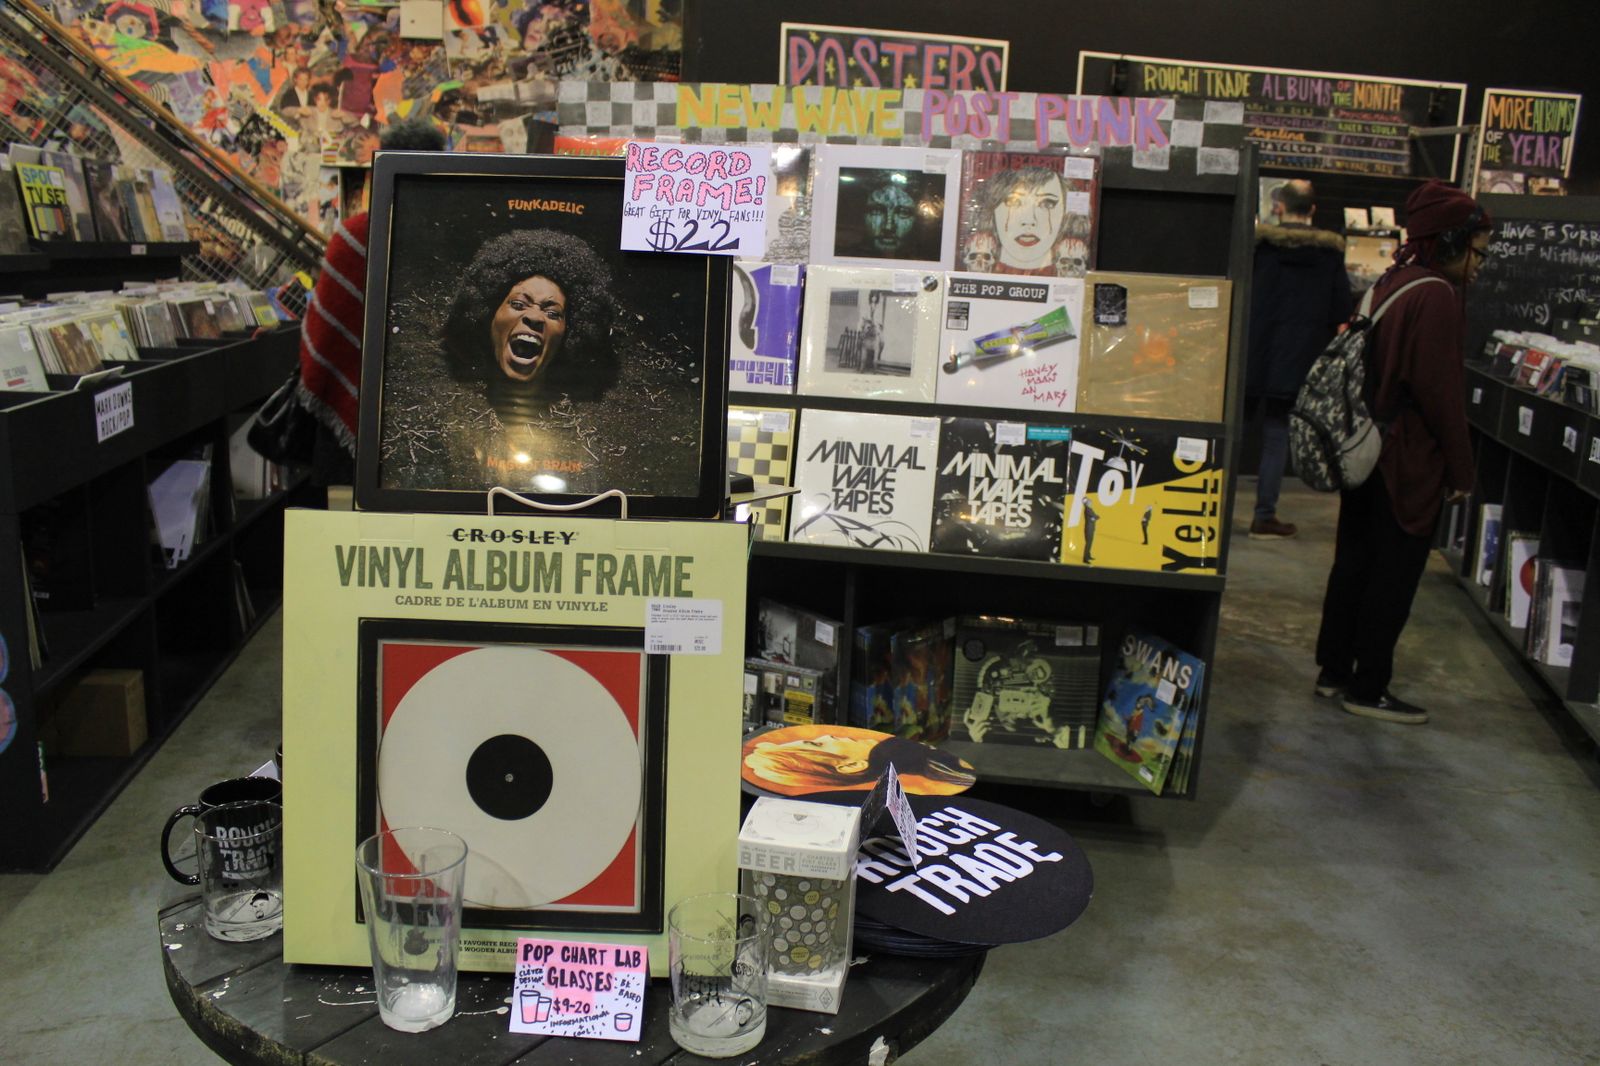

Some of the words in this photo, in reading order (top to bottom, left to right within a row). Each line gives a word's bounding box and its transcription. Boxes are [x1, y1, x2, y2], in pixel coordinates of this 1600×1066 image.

[788, 33, 1002, 94] POSTERS
[1144, 64, 1199, 93] ROUGH
[1204, 69, 1252, 97] TRADE
[1262, 74, 1332, 107] ALBUMS
[1337, 80, 1350, 91] OF
[1333, 92, 1351, 106] THE
[1353, 82, 1404, 111] MONTH
[675, 84, 785, 131] NEW
[792, 86, 904, 139] WAVE
[921, 90, 1020, 144] POST
[1035, 93, 1170, 151] PUNK
[1487, 95, 1534, 131] MORE
[1532, 98, 1575, 133] ALBUMS
[1486, 131, 1504, 143] OF
[626, 143, 751, 180] RECORD
[1483, 144, 1501, 162] THE
[1508, 132, 1571, 170] YEAR!
[27, 186, 42, 202] TV
[632, 174, 766, 210] FRAME!
[508, 199, 585, 215] FUNKADELIC
[624, 202, 646, 217] GREAT
[650, 204, 674, 219] GIFT
[678, 208, 691, 220] FOR
[696, 209, 724, 221] VINYL
[729, 210, 764, 222] FANS!!!
[645, 217, 740, 252] $22
[953, 283, 976, 294] THE
[980, 285, 1005, 296] POP
[1009, 287, 1046, 299] GROUP
[806, 440, 926, 470] MINIMAL
[941, 451, 1063, 483] MINIMAL
[832, 465, 897, 491] WAVE
[968, 476, 1034, 505] WAVE
[831, 488, 895, 515] TAPES
[970, 501, 1032, 528] TAPES
[452, 528, 576, 545] CROSLEY
[335, 544, 433, 589] VINYL
[442, 548, 562, 593] ALBUM
[574, 552, 694, 598] FRAME
[395, 595, 442, 606] CADRE
[445, 597, 465, 607] DE
[467, 597, 527, 609] L'ALBUM
[533, 599, 552, 610] EN
[556, 600, 608, 612] VINYLE
[1122, 634, 1193, 689] SWANS
[740, 851, 796, 872] BEER
[885, 831, 1064, 915] TRADE
[523, 944, 554, 963] POP
[561, 946, 607, 966] CHART
[614, 949, 641, 968] LAB
[547, 966, 613, 992] GLASSES
[553, 998, 590, 1014] $9-20
[618, 989, 641, 1003] BASED
[550, 1010, 610, 1027] INFORMATIONAL
